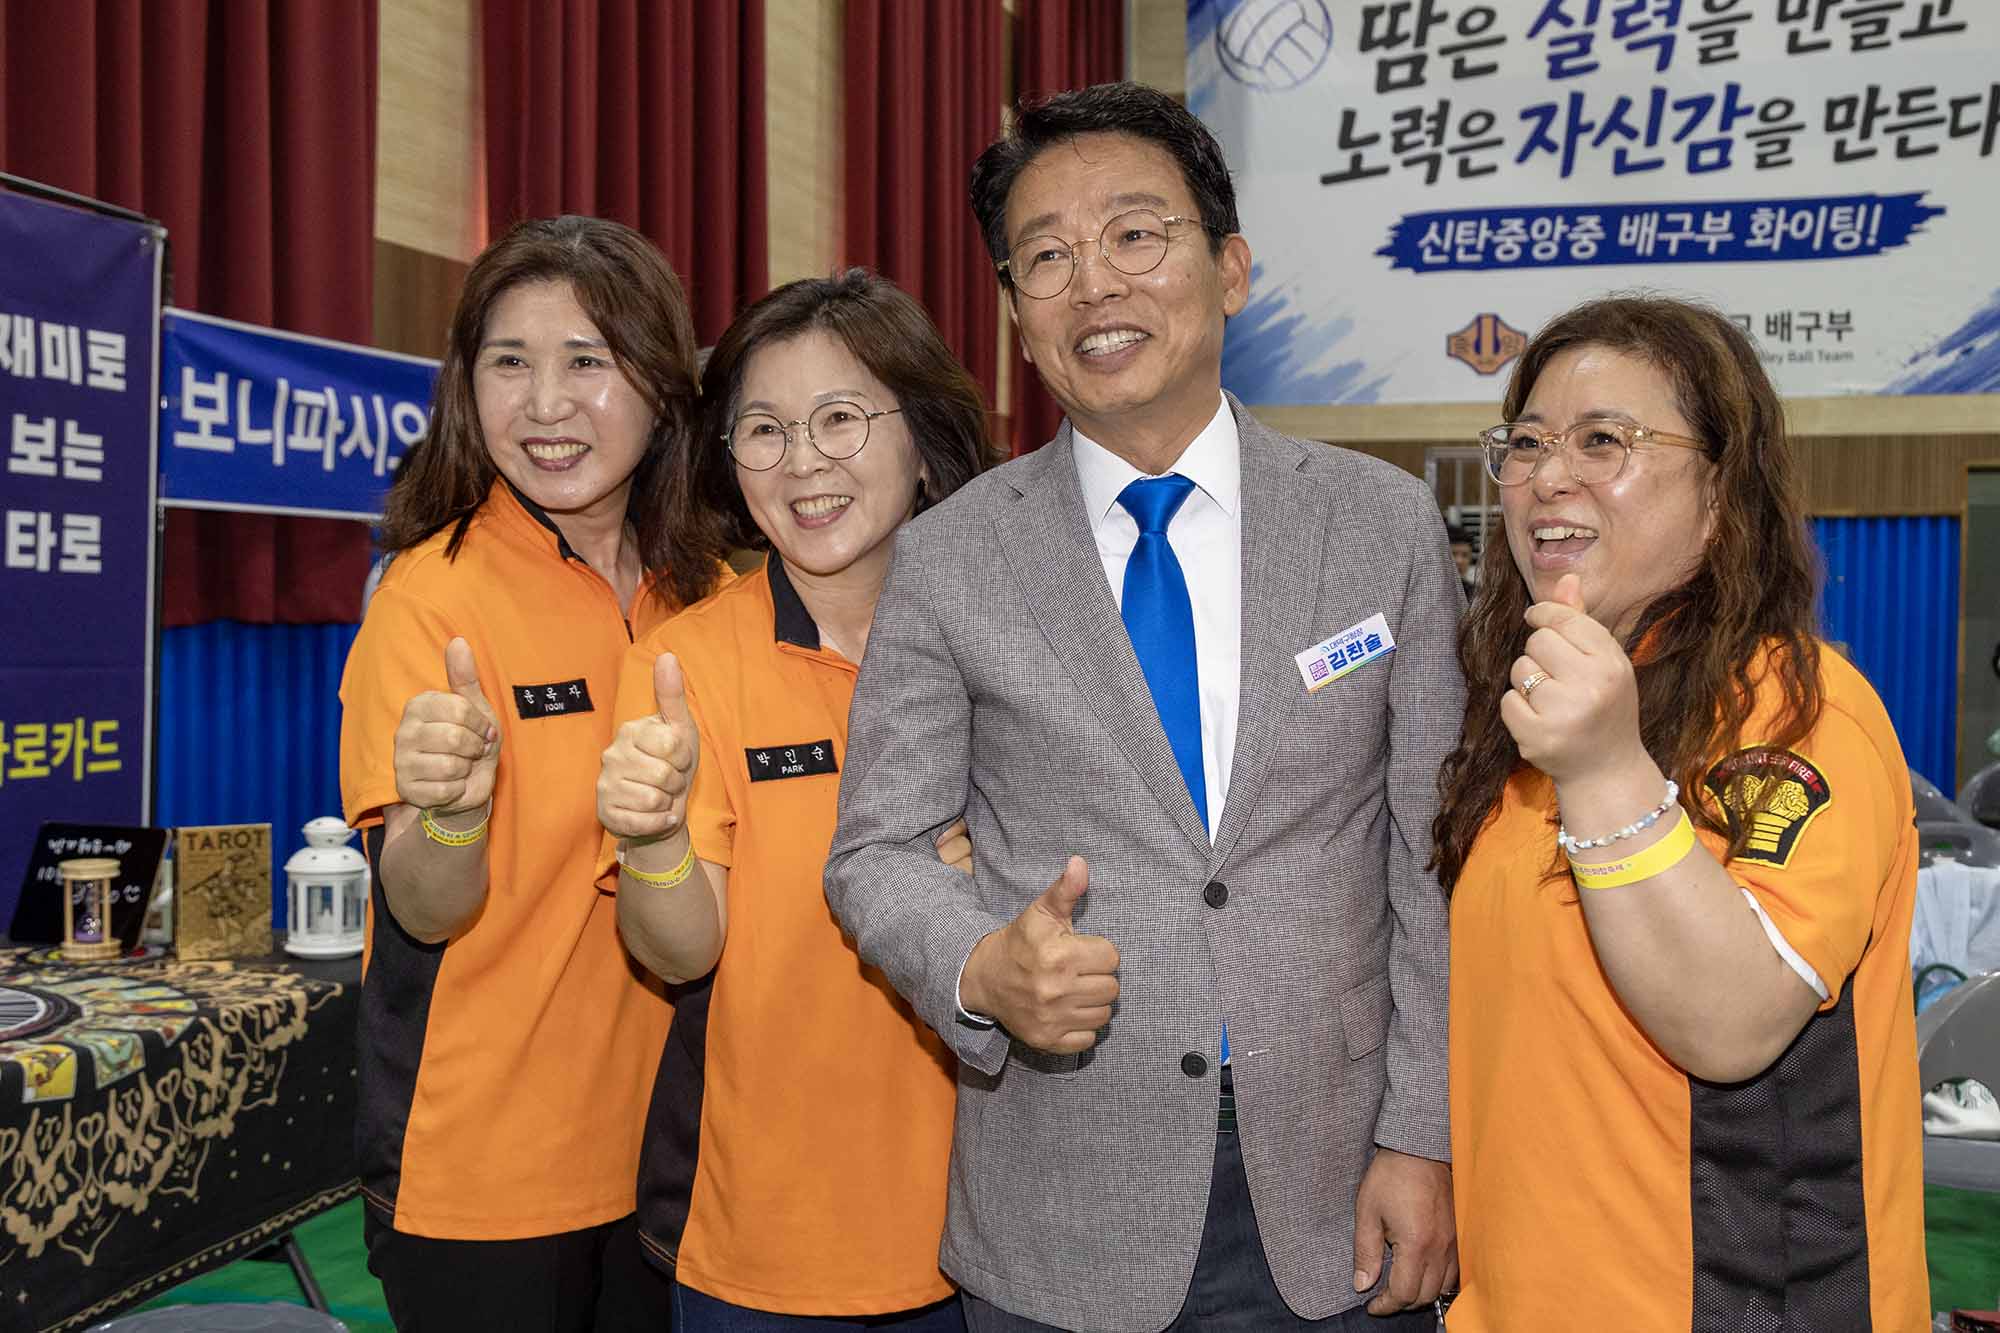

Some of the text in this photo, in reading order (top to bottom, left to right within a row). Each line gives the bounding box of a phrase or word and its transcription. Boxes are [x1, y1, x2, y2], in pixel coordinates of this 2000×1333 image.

[1358, 0, 1507, 93] 땀은
[1525, 0, 1753, 80] 실력을
[1319, 82, 2000, 186] 노력은 자신감을 만든다
[1417, 203, 1883, 265] 신탄중앙중 배구부 화이팅!
[0, 312, 127, 393] 재미로
[1764, 309, 1854, 343] 배구부
[1818, 349, 1854, 363] Team
[7, 412, 105, 482] 보는
[4, 509, 103, 575] 타로
[781, 764, 805, 775] PARK
[1788, 760, 1813, 782] FIRE
[183, 829, 265, 851] TAROT
